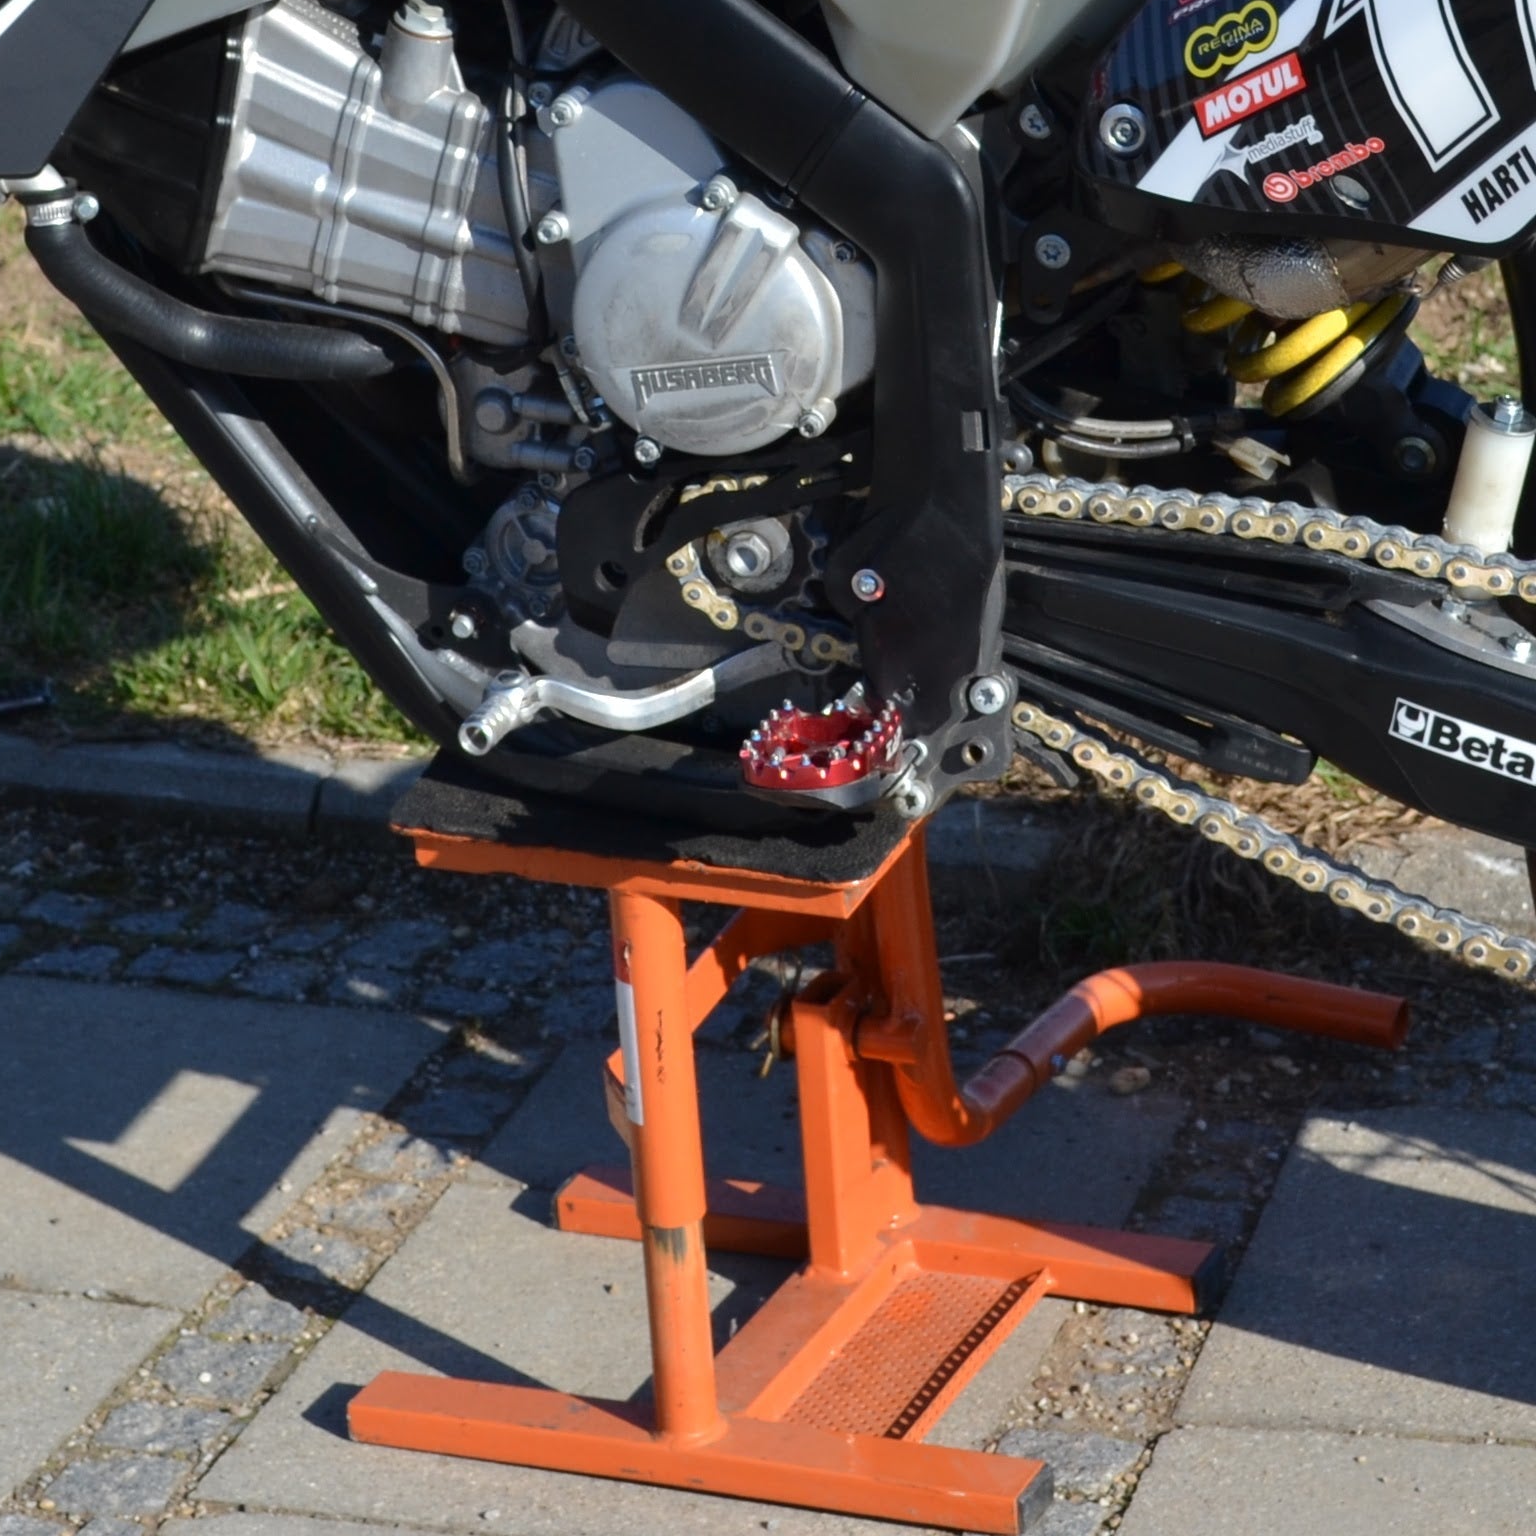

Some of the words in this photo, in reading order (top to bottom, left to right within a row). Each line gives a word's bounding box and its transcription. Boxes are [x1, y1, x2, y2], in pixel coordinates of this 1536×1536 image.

[1197, 17, 1263, 56] REGINA
[1226, 25, 1264, 47] CHAIN
[1204, 61, 1299, 129] MOTUL
[1248, 118, 1314, 162] mediastuff
[1291, 137, 1385, 188] brembo
[631, 353, 782, 411] HUSABERG
[1430, 716, 1536, 780] Beta
